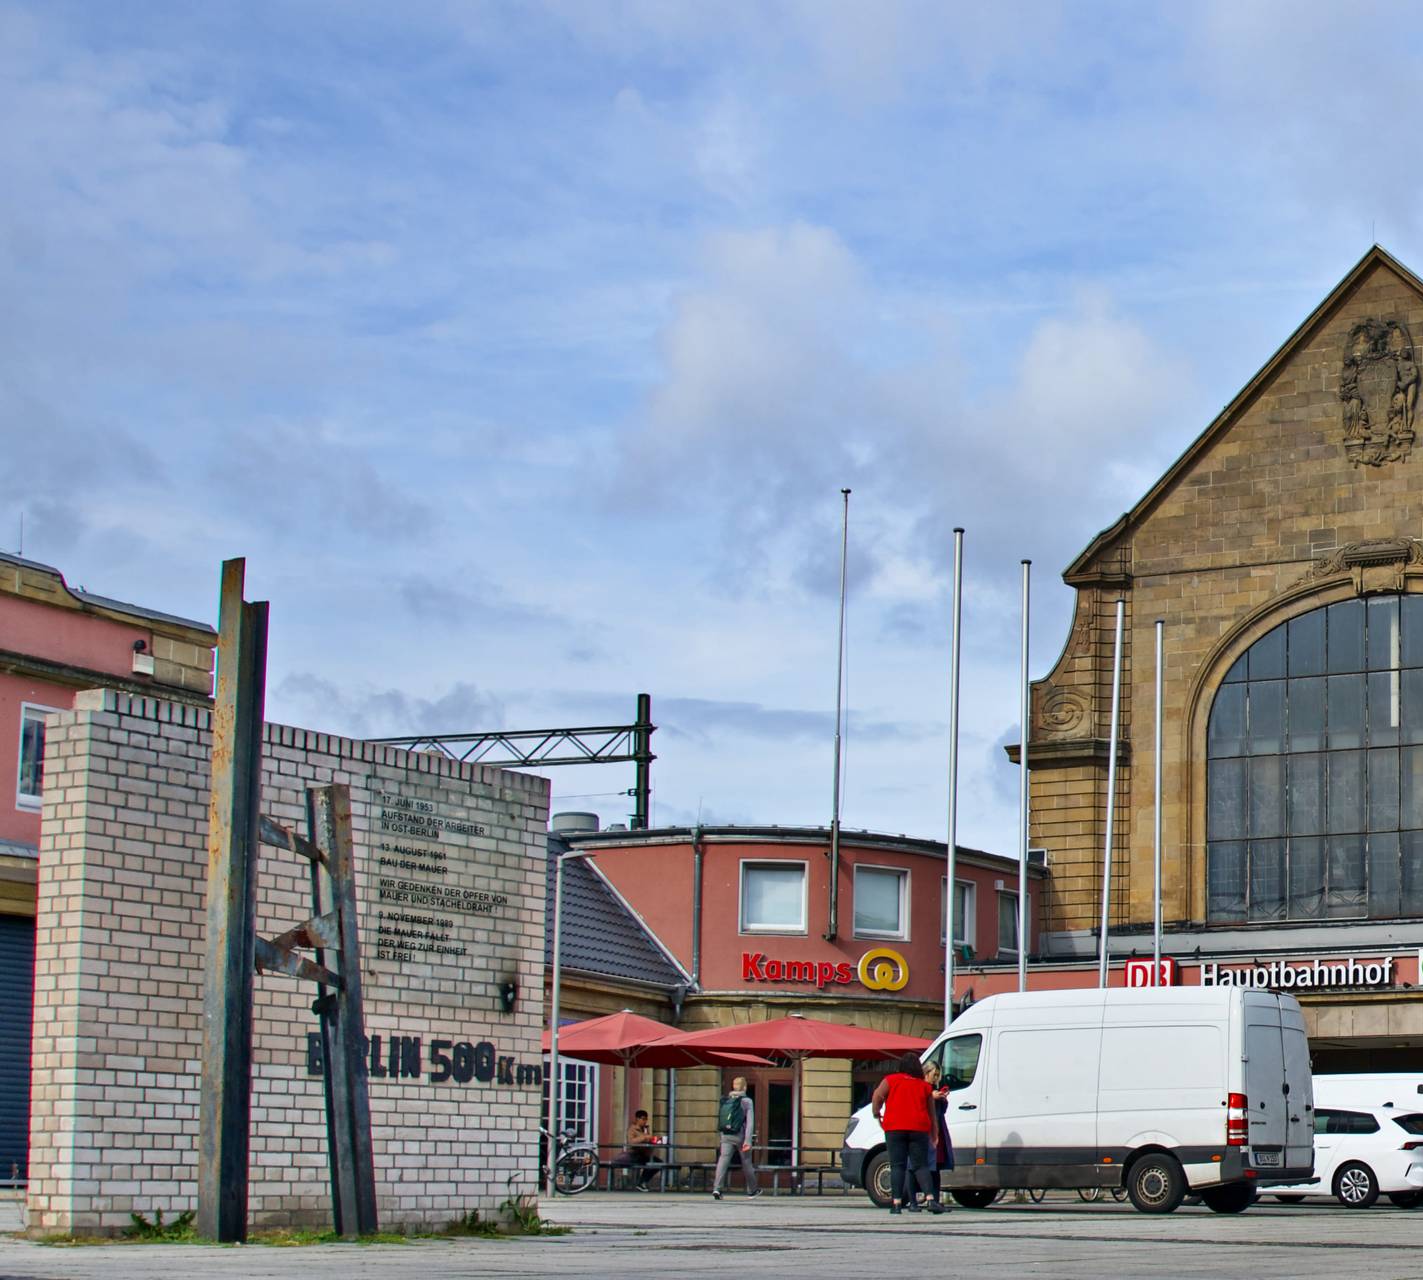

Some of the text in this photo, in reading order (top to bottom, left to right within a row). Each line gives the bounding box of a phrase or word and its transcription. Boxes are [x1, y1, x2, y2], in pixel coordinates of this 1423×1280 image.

[395, 797, 413, 808] JUNI
[416, 802, 433, 812] 1953
[381, 822, 439, 839] IN OST-BERLIN
[382, 810, 485, 836] AUFSTAND DER ARBEITER
[394, 845, 428, 857] AUGUST
[430, 851, 447, 860] 1961
[380, 857, 448, 875] BAU DER MAUER
[380, 878, 508, 904] WIR GEDENKEN DER OPFER VON
[380, 889, 408, 901] MAUER
[411, 894, 429, 904] UND
[430, 896, 493, 913] STACHELDRAHT
[388, 912, 434, 925] NOVEMBER
[378, 926, 392, 935] DIE
[394, 927, 423, 939] MAUER
[378, 938, 467, 956] DER WEG ZUR EINHEIT
[378, 950, 390, 960] IST
[393, 951, 411, 962] FREI
[742, 952, 852, 989] Kamps
[1200, 957, 1392, 988] Hauptbahnhof
[308, 1032, 542, 1086] BLIN 500 Km
